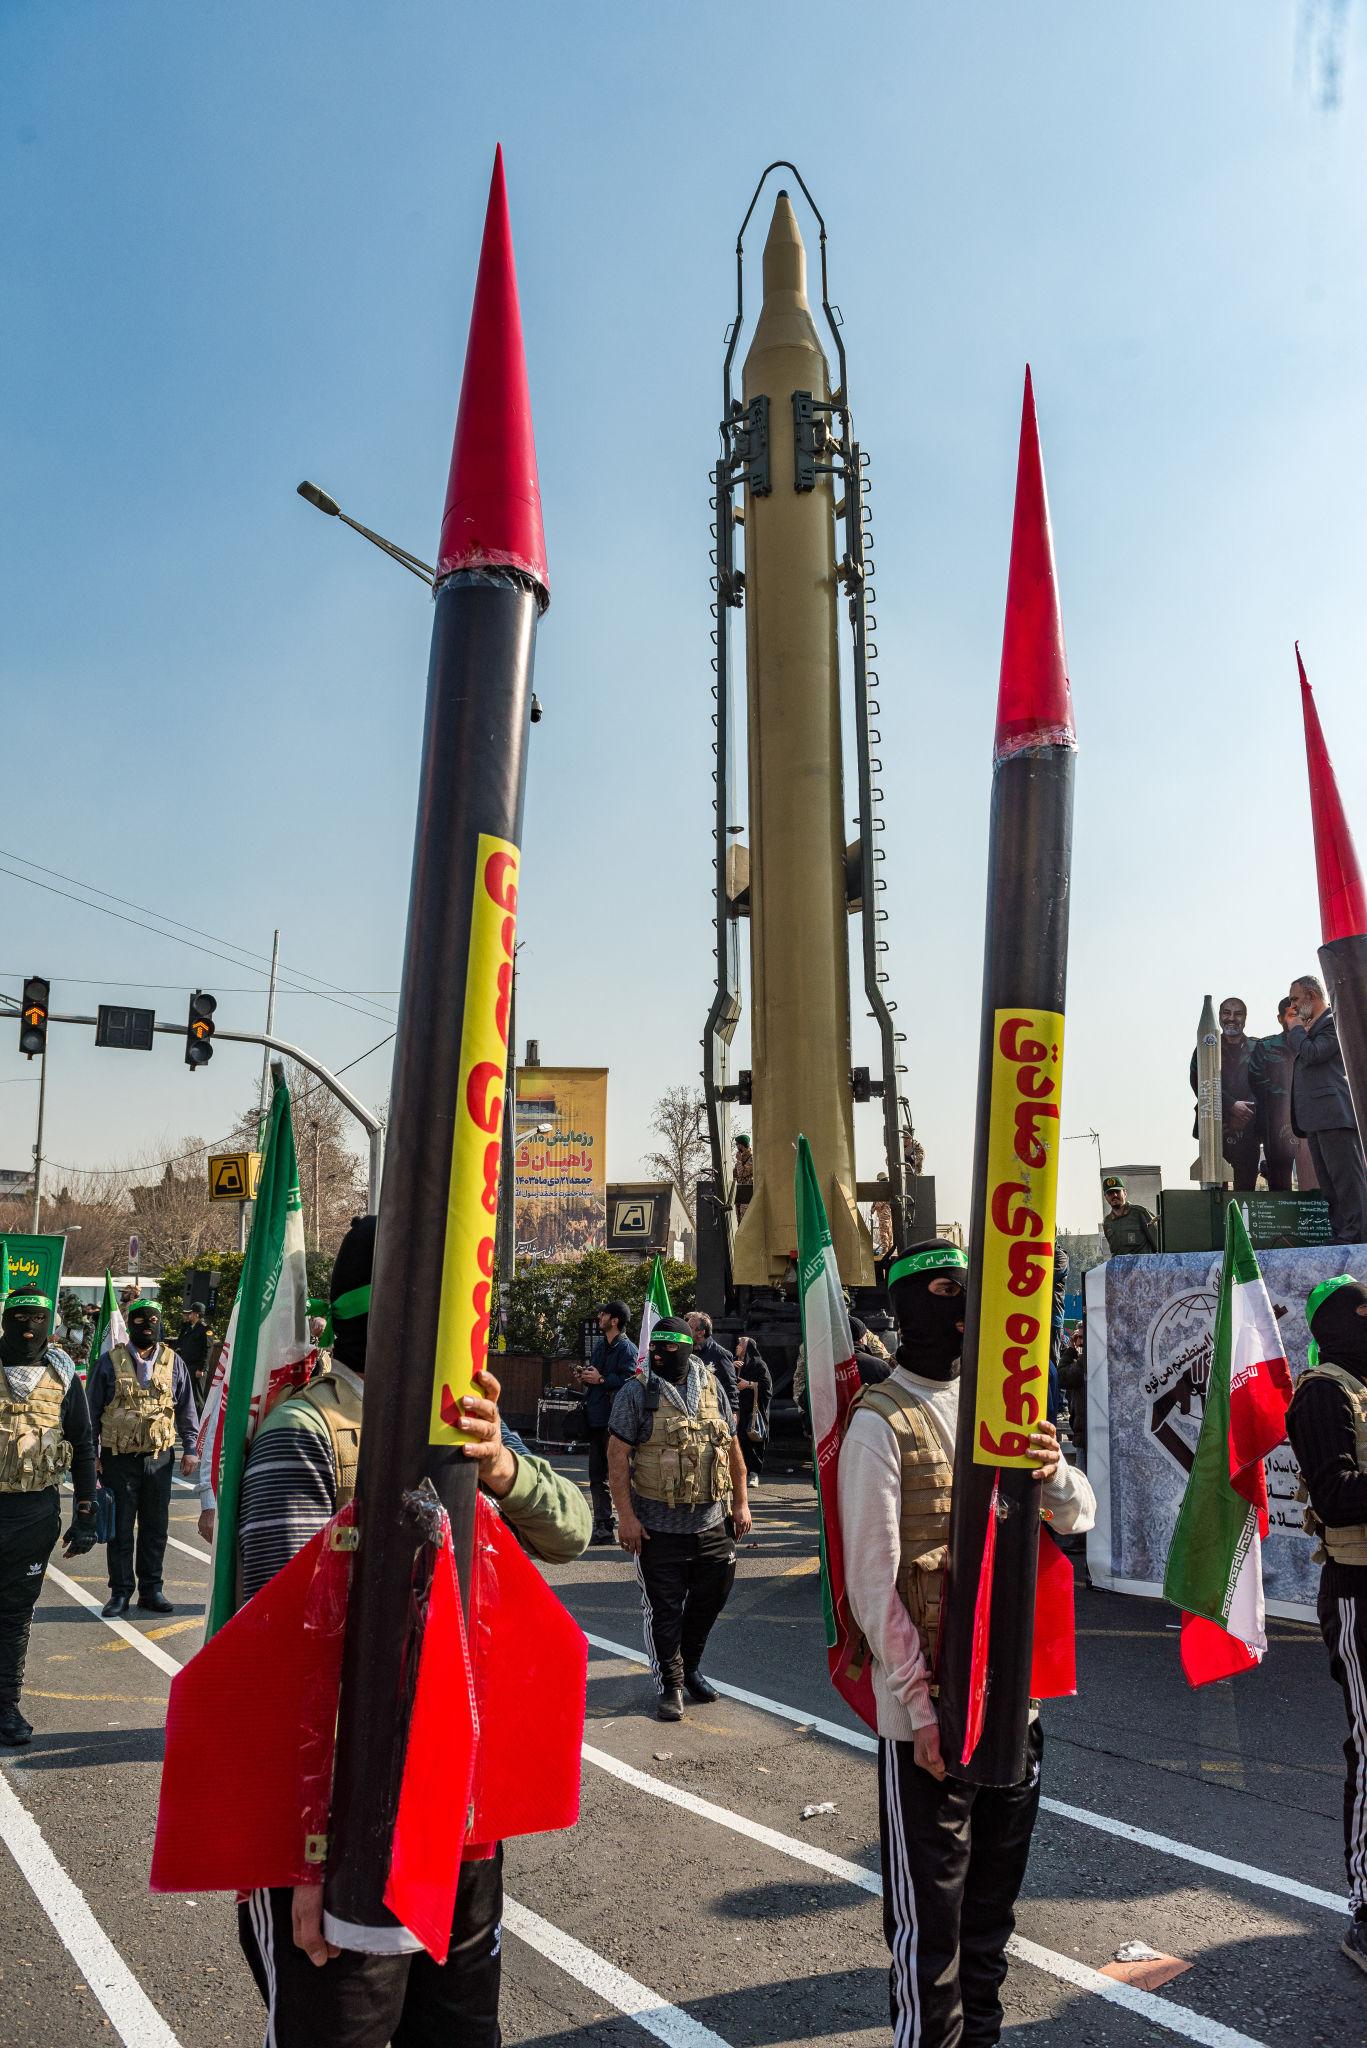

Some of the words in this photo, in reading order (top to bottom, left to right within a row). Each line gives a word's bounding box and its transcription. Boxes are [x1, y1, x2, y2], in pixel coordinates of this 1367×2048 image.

[999, 1017, 1060, 1170] صادق
[547, 1129, 594, 1146] رزمایش
[531, 1150, 593, 1173] راهیان
[547, 1177, 560, 1187] دی
[569, 1177, 593, 1187] جمعه
[991, 1181, 1053, 1298] های
[925, 1256, 934, 1266] ام
[936, 1254, 960, 1266] لیمانی
[979, 1312, 1042, 1457] وعده
